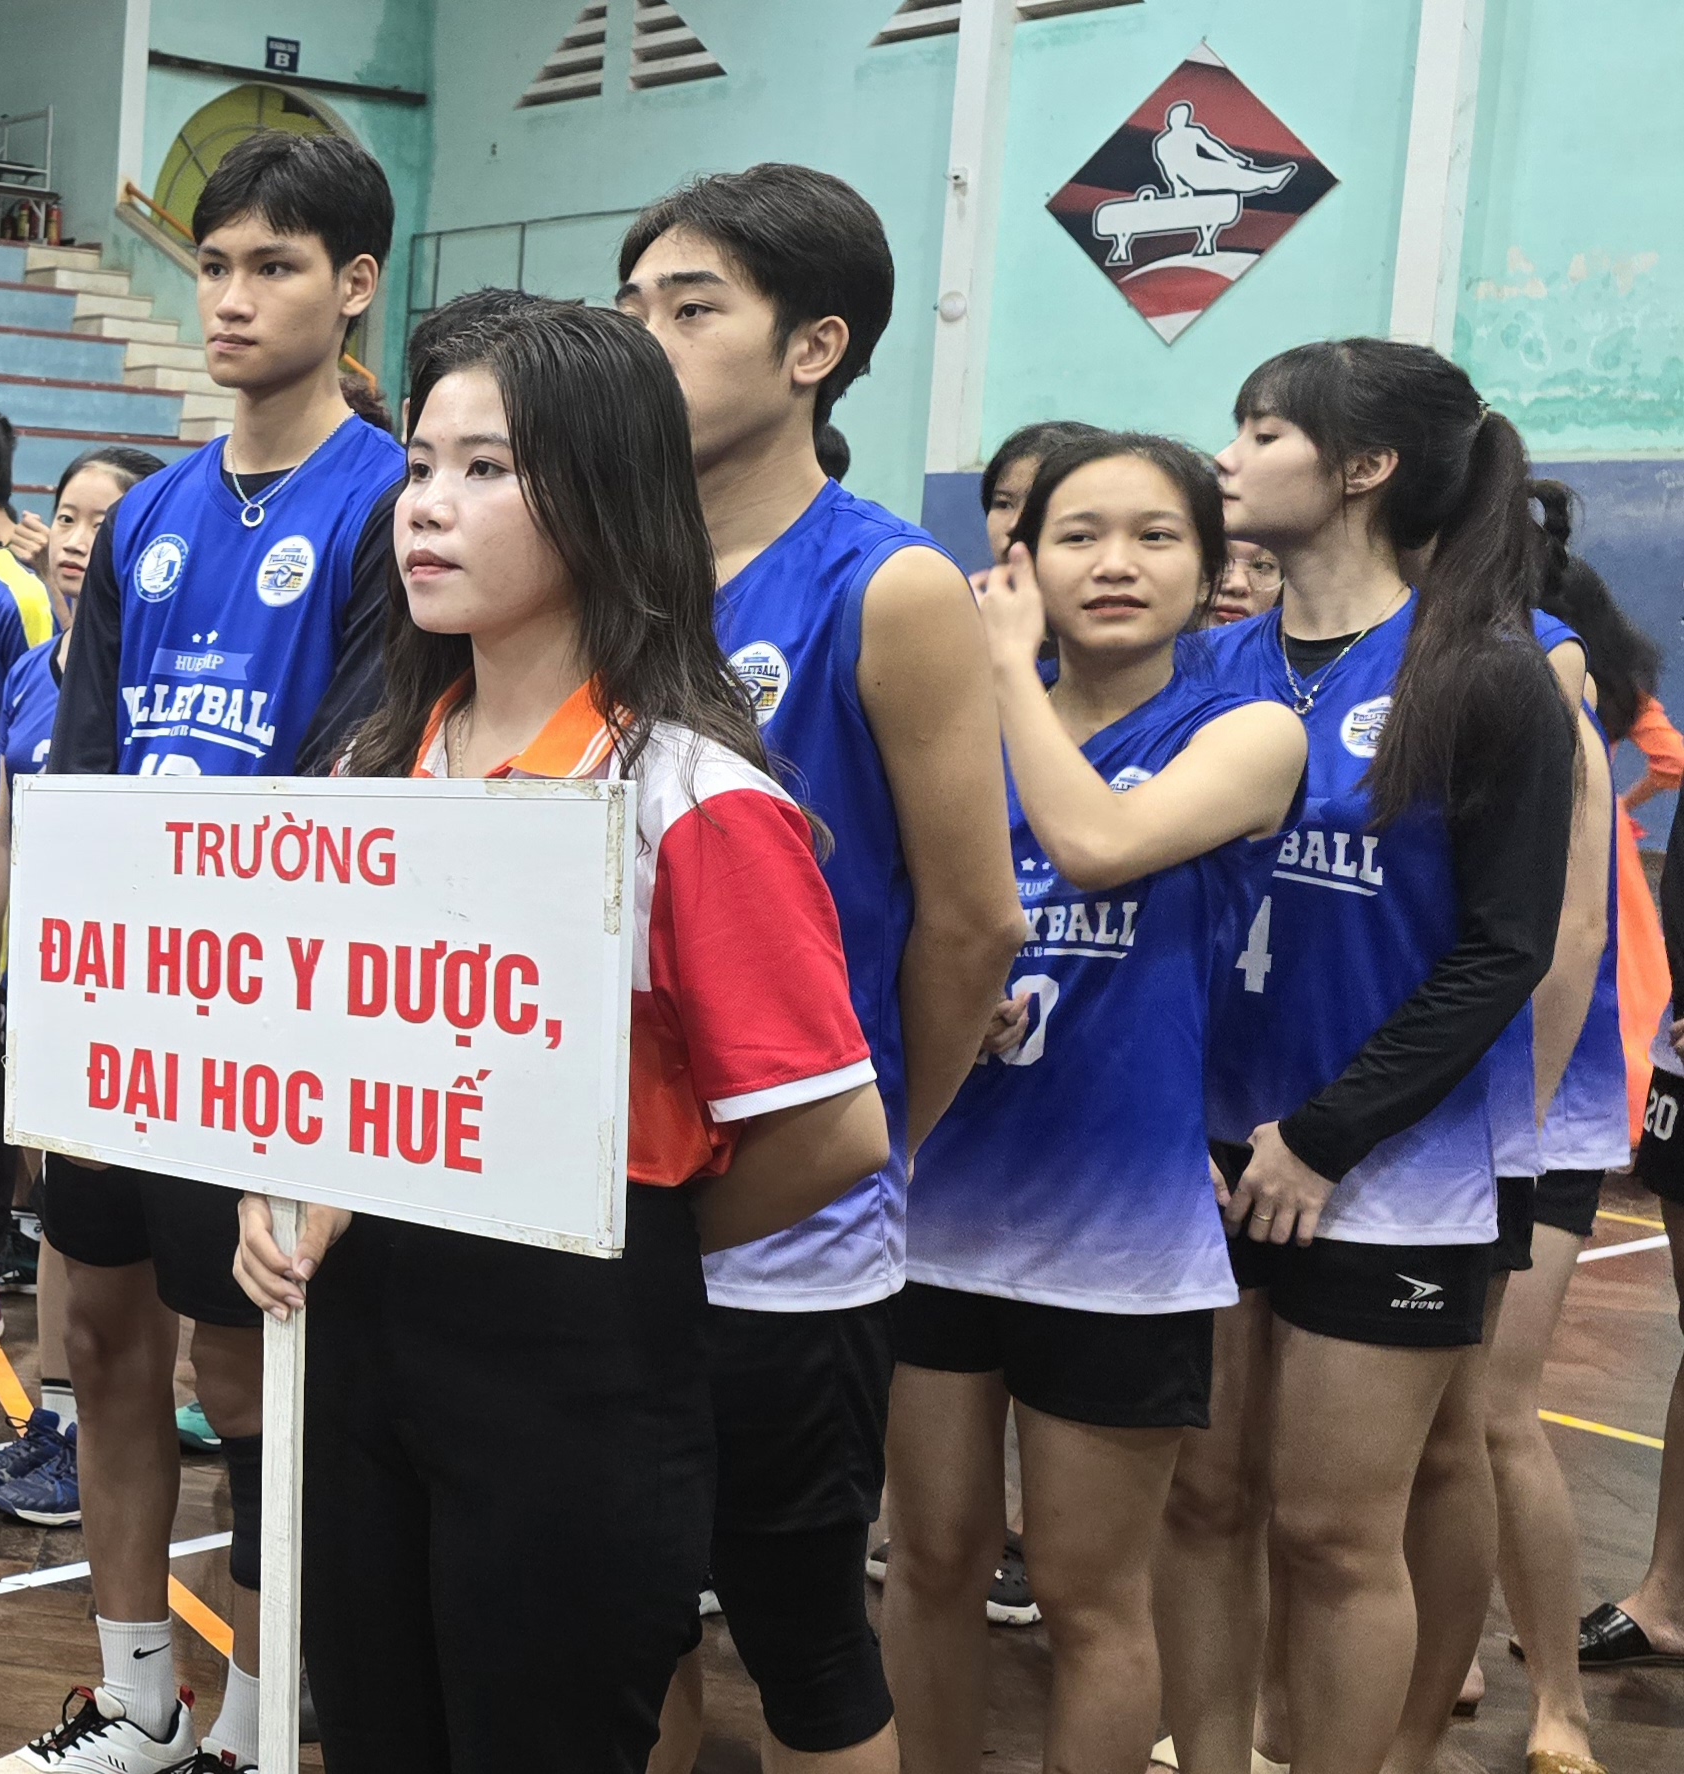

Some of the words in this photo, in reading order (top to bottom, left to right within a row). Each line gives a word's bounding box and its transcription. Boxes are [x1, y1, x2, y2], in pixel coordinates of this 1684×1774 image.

[164, 811, 398, 886] TRƯỜNG
[39, 917, 126, 1002] ĐẠI
[147, 925, 264, 1016] HỌC
[286, 936, 325, 1012] Y
[347, 940, 563, 1050] DƯỢC,
[86, 1041, 179, 1133] ĐẠI
[200, 1057, 324, 1155] HỌC
[349, 1069, 493, 1175] HUẾ
